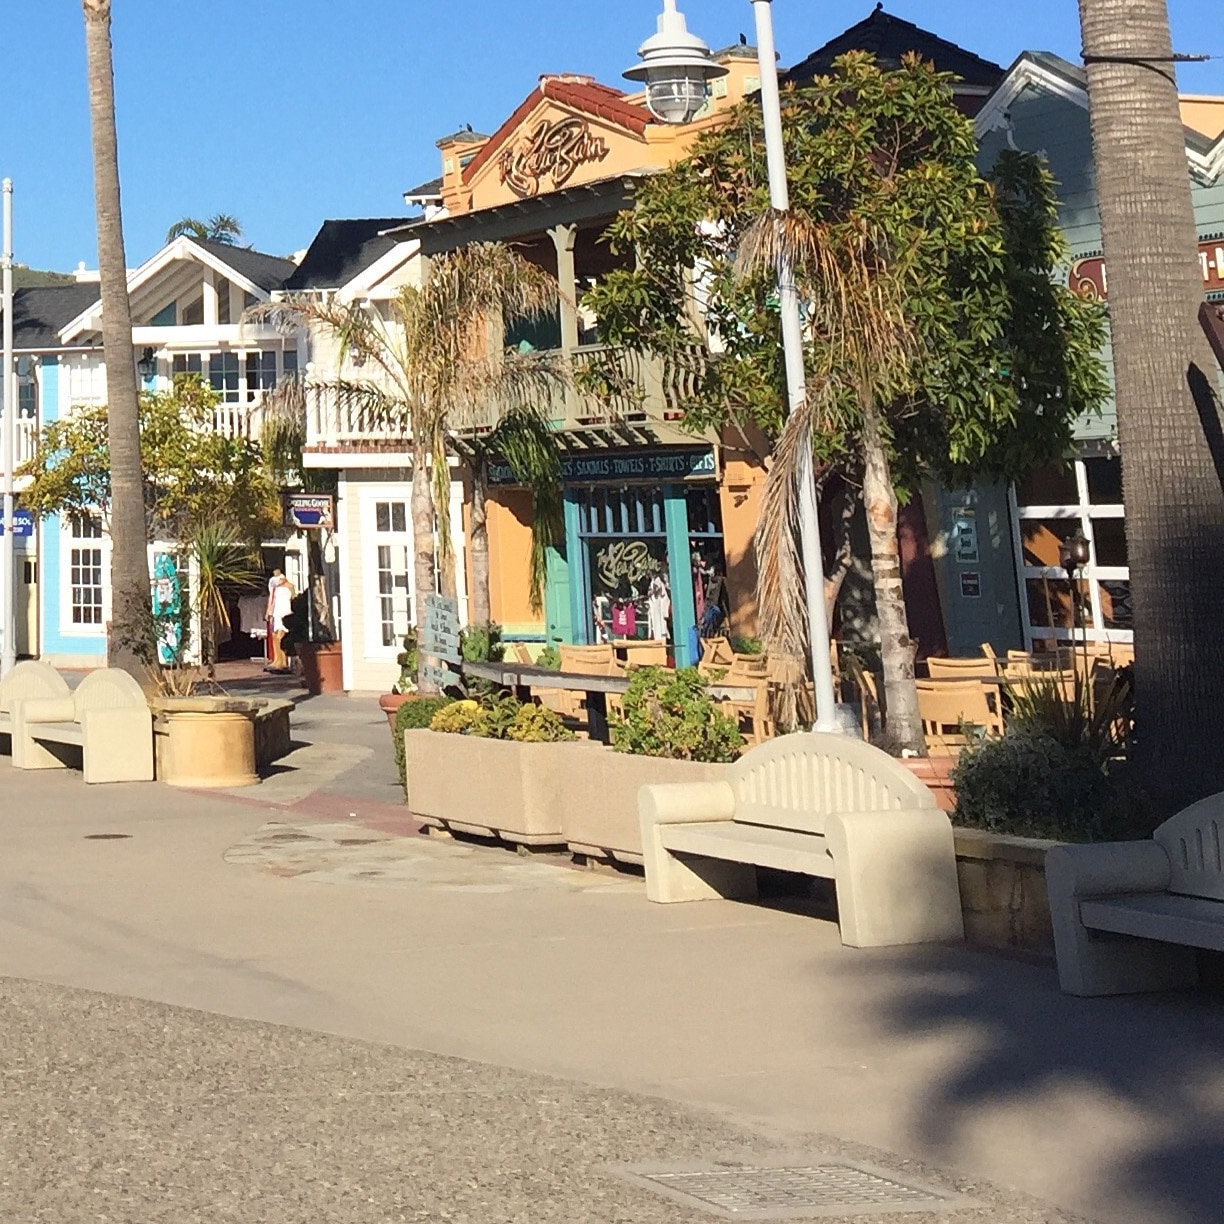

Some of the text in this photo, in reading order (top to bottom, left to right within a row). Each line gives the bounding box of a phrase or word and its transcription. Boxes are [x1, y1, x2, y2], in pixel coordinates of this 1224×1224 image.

[544, 116, 610, 188] Barn
[613, 458, 644, 474] TOWELS
[649, 456, 685, 473] T-SHIRTS
